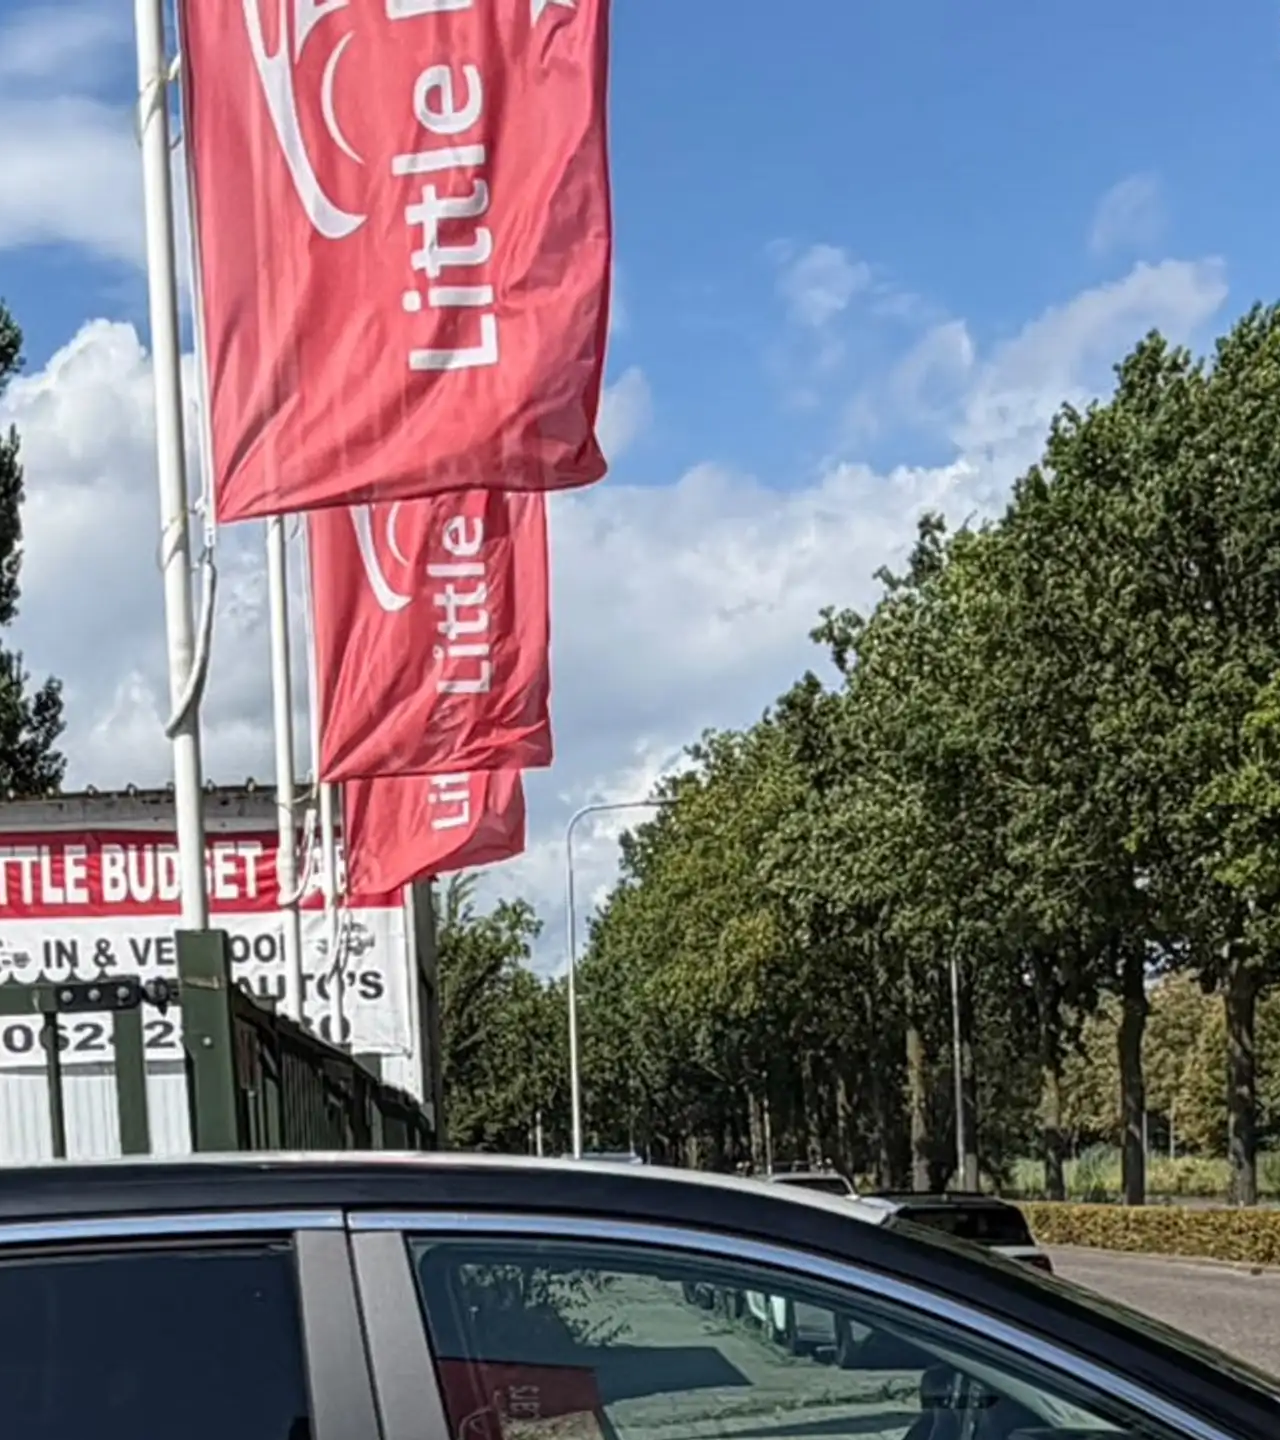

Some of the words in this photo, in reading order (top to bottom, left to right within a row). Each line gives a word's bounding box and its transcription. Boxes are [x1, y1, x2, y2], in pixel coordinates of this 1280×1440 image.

[392, 63, 498, 371] Little
[425, 515, 491, 694] Little
[100, 840, 263, 903] BUDET
[43, 938, 79, 969] IN
[93, 937, 118, 968] &
